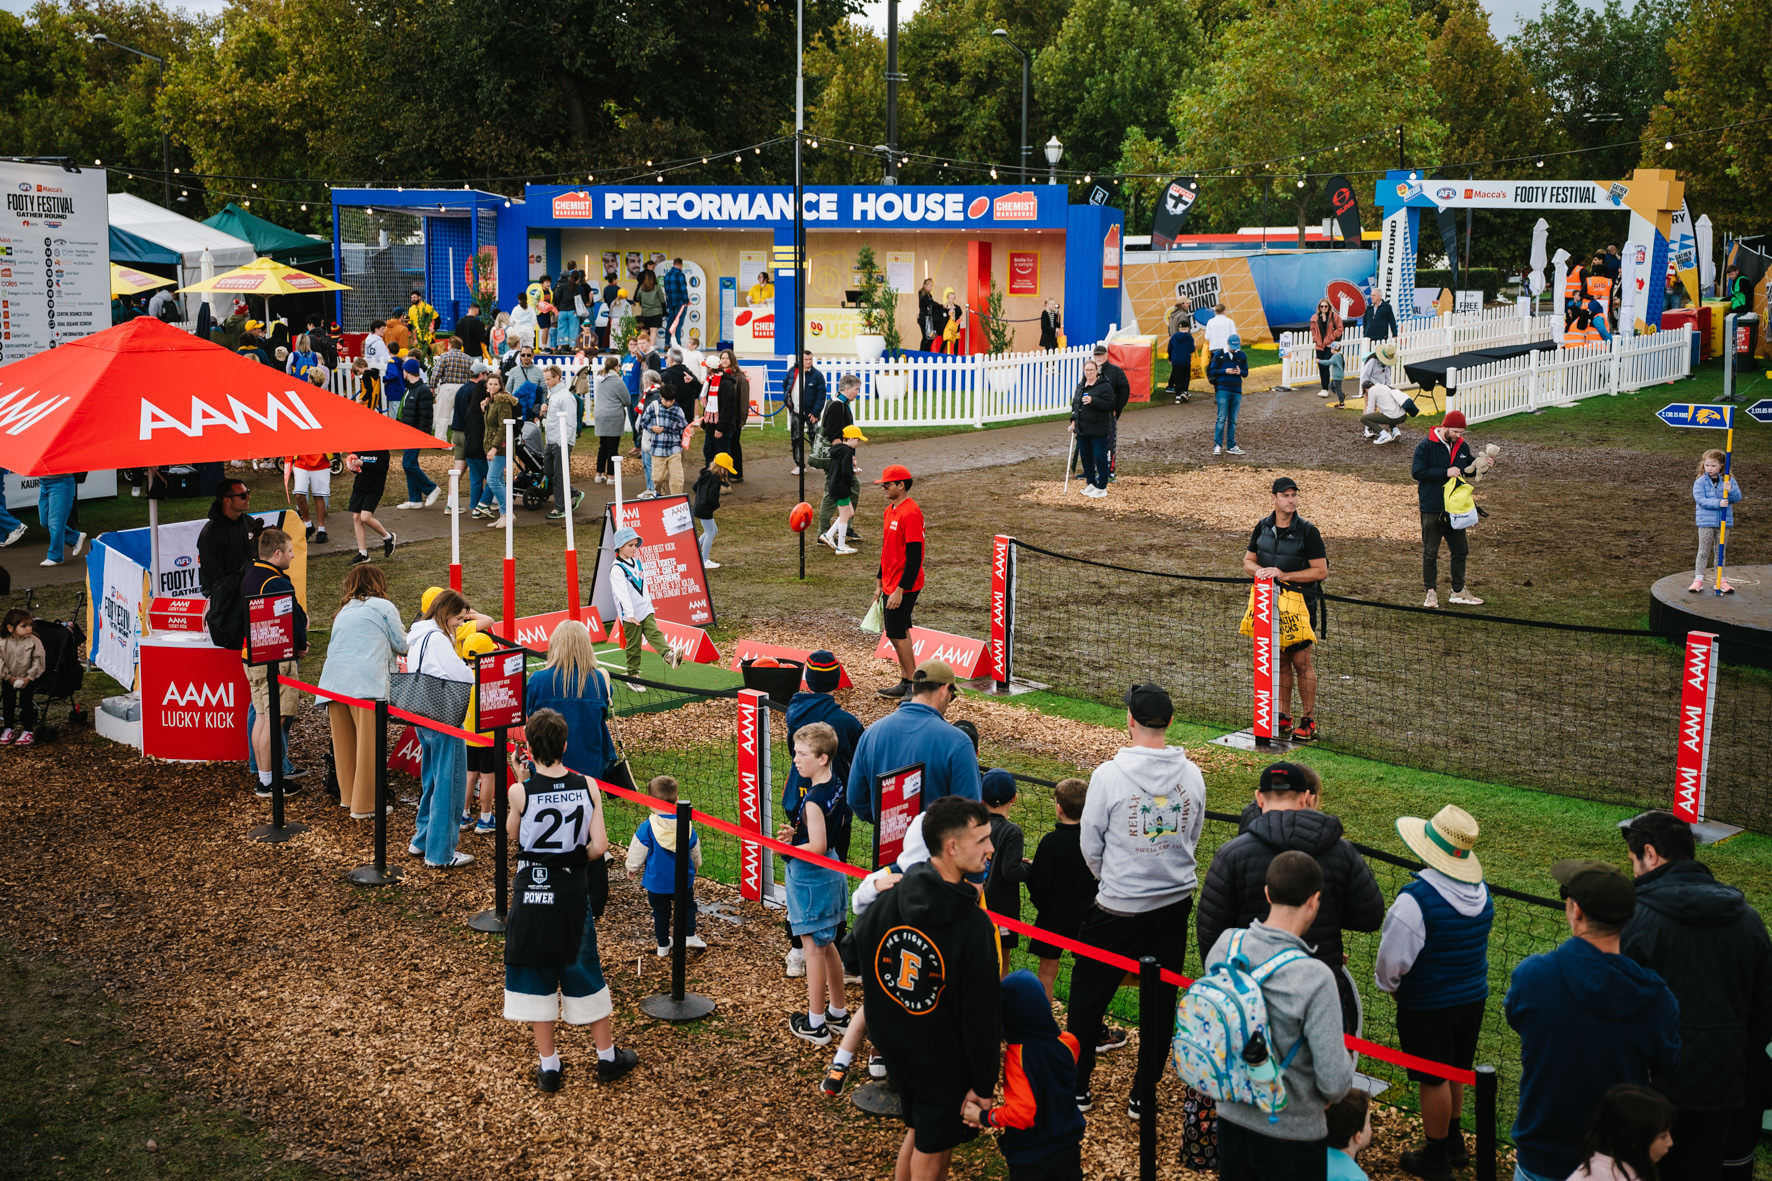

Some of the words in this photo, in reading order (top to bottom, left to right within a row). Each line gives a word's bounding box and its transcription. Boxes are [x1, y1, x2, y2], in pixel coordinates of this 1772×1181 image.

[7, 193, 34, 212] FOOTY
[37, 195, 74, 214] FESTIVAL
[1438, 188, 1456, 199] AFL
[1474, 189, 1507, 199] Macca's
[1514, 186, 1548, 203] FOOTY
[1550, 186, 1596, 204] FESTIVAL
[45, 212, 67, 220] ROUND
[555, 201, 590, 210] CHEMIST
[605, 192, 838, 221] PERFORMANCE
[852, 193, 964, 221] HOUSE
[997, 202, 1035, 211] CHEMIST
[1387, 220, 1397, 264] ROUND
[1178, 276, 1218, 298] GATHER
[1188, 293, 1217, 315] OUND
[1460, 302, 1479, 310] FREE
[754, 322, 774, 331] CHEM
[0, 382, 71, 435] AMI
[139, 390, 323, 441] AAMI
[21, 479, 40, 490] KAUR
[621, 507, 640, 520] AMI
[671, 504, 689, 516] AAMI
[665, 542, 676, 551] KICK
[176, 555, 191, 567] AFL
[994, 543, 1006, 580] AAMI
[160, 568, 195, 592] FOOTY
[172, 586, 203, 597] GATHE
[663, 588, 681, 598] SUNDAY
[689, 599, 707, 609] AAMI
[993, 591, 1004, 628] AAMI
[1257, 583, 1270, 624] AAMI
[480, 656, 495, 665] AAMI
[931, 643, 974, 668] AAMI
[993, 639, 1004, 675] AAMI
[1256, 636, 1270, 677] AAMI
[1688, 643, 1708, 691] AAMI
[162, 681, 234, 708] AAMI
[162, 711, 200, 728] LUCKY
[205, 711, 235, 729] KICK
[1256, 690, 1270, 730] AAMI
[742, 703, 755, 756] AAMI
[1683, 705, 1702, 752] AAMI
[398, 739, 424, 763] AA
[882, 776, 896, 787] AAMI
[1678, 767, 1698, 814] AAMI
[538, 792, 583, 805] FRENCH
[742, 772, 757, 823] AAMI
[532, 805, 585, 849] 21
[743, 838, 760, 891] AAMI
[523, 891, 555, 904] POWER
[903, 932, 928, 951] FIGHT
[897, 948, 922, 991] F
